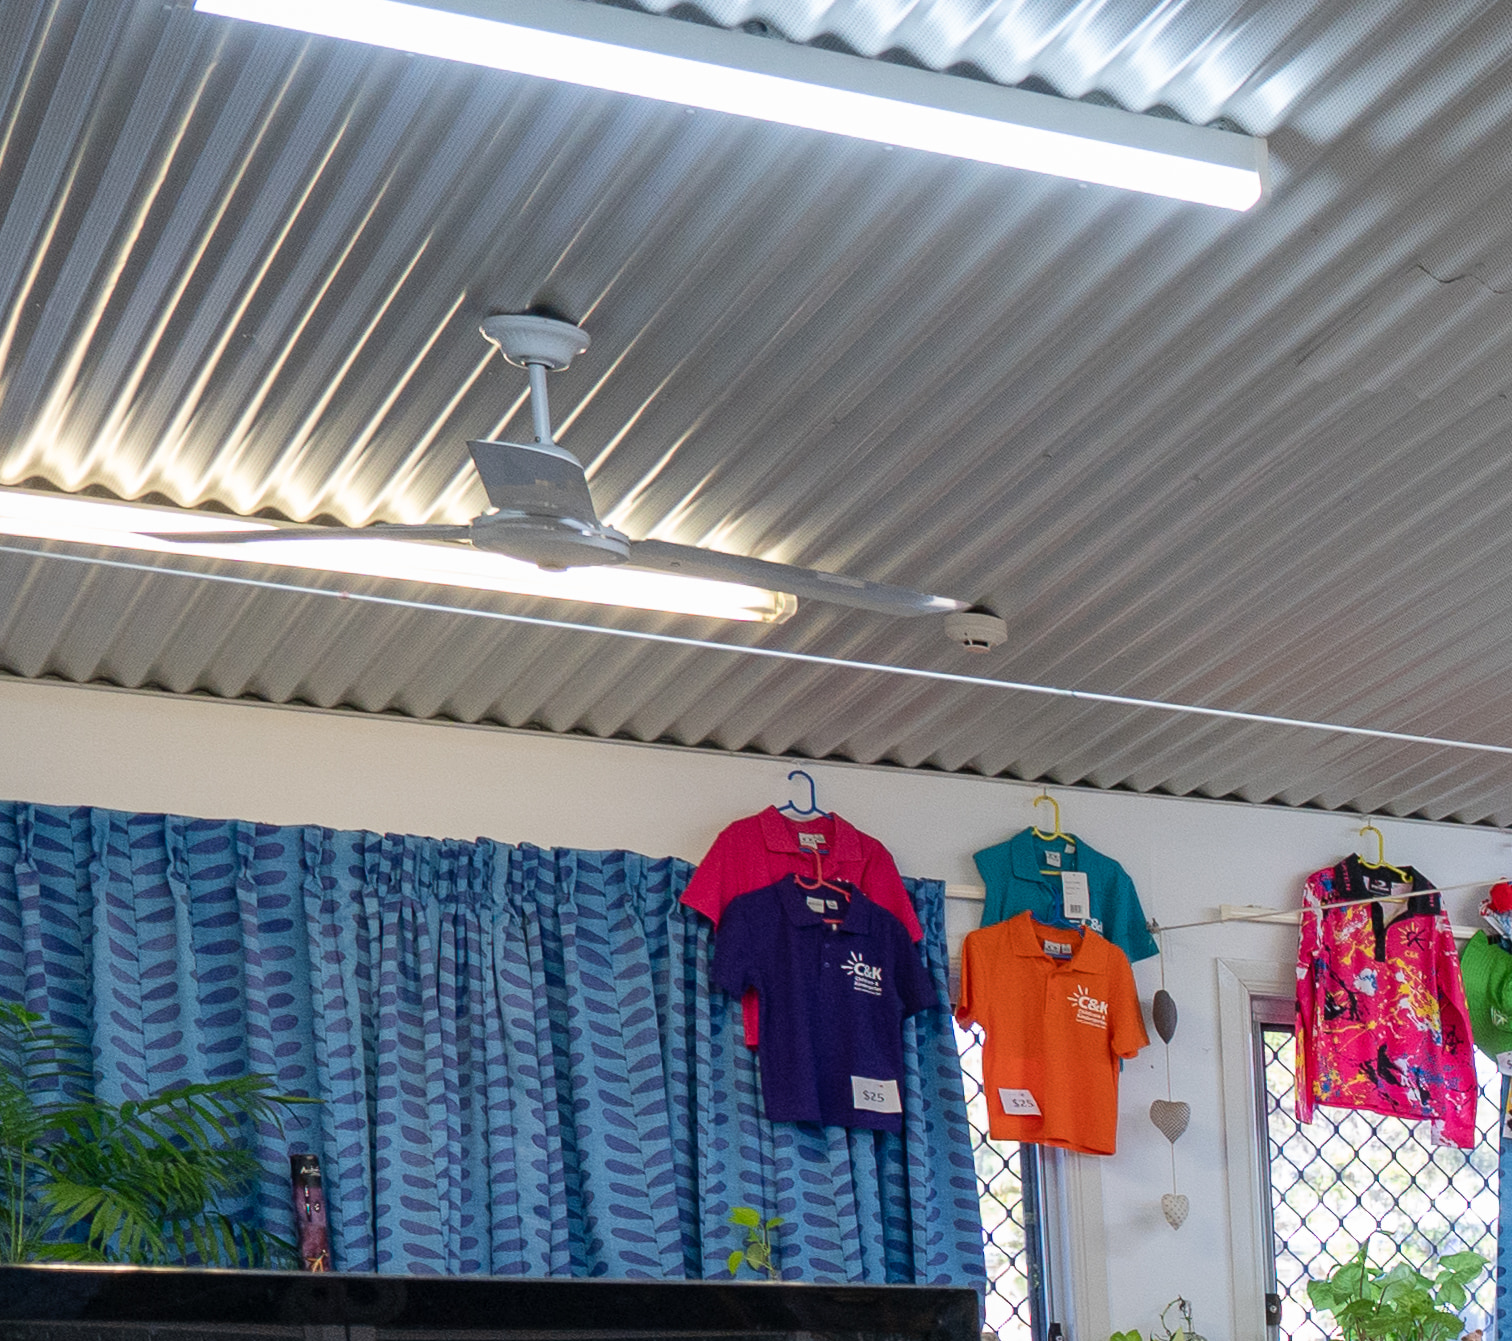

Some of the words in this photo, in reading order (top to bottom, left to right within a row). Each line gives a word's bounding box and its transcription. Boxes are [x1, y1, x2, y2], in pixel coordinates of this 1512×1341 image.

[1078, 996, 1108, 1015] C&K
[862, 1089, 885, 1103] $25
[1012, 1098, 1035, 1108] $25
